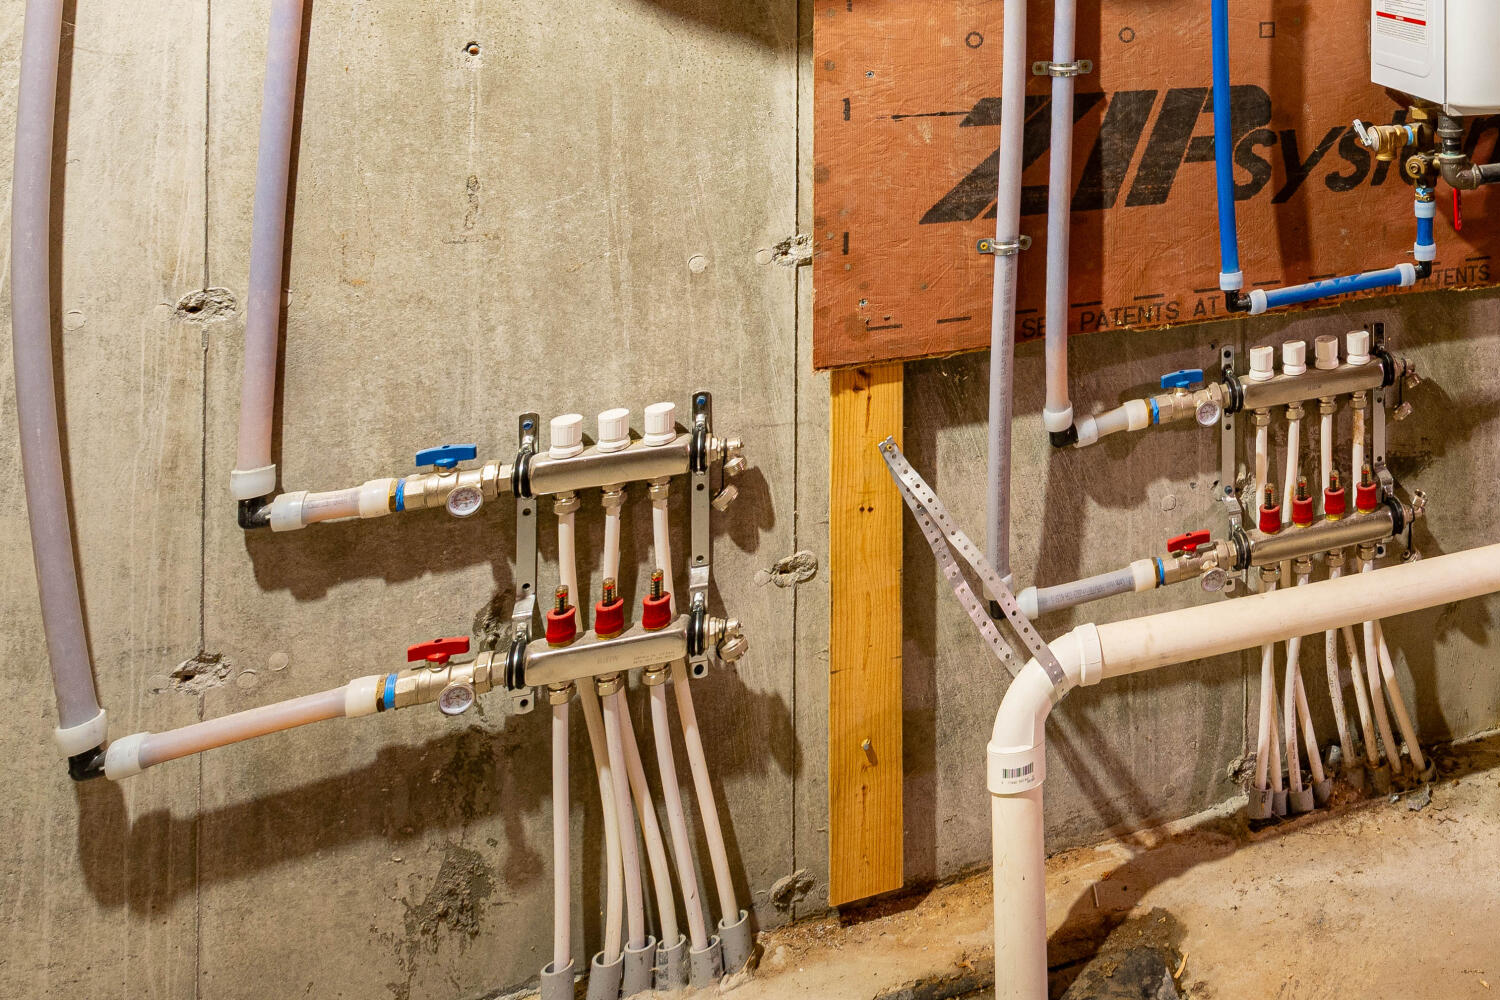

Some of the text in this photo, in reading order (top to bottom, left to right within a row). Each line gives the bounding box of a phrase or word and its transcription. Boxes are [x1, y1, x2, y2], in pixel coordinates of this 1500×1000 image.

[1022, 316, 1046, 338] SE
[1080, 300, 1180, 331] PATENTS
[1193, 296, 1220, 317] AT
